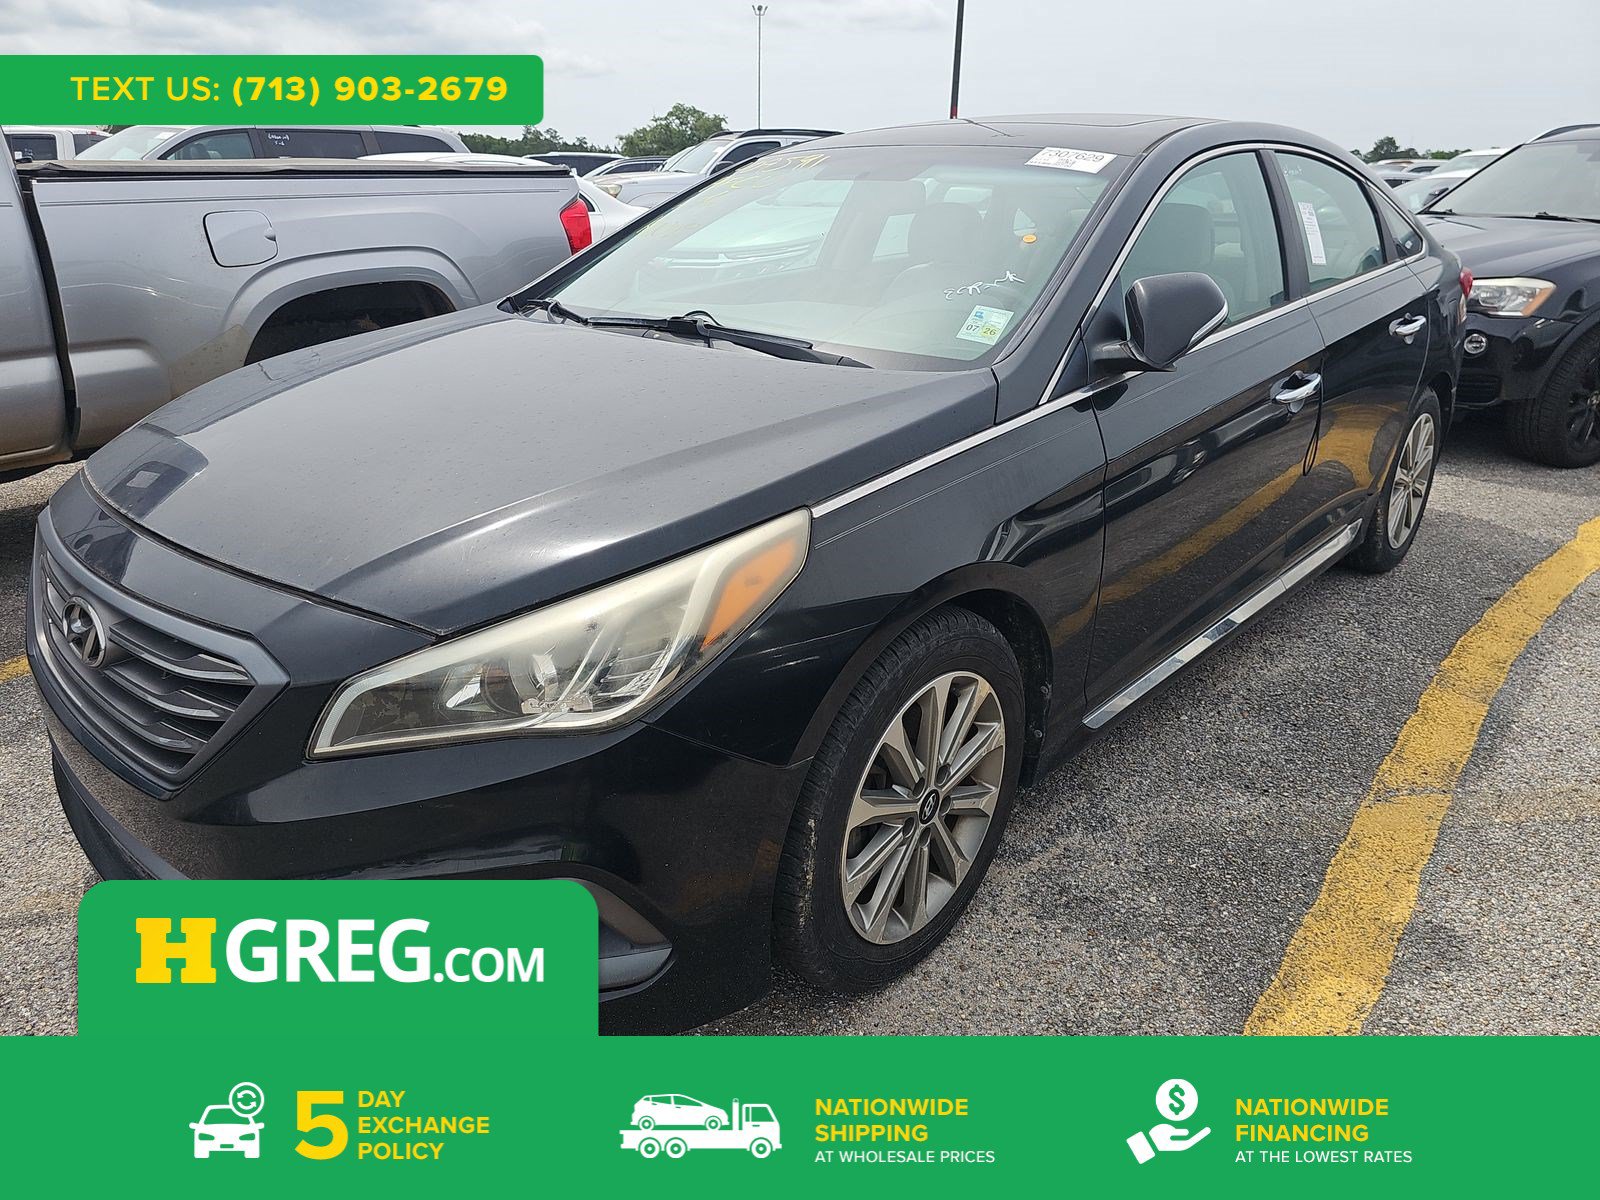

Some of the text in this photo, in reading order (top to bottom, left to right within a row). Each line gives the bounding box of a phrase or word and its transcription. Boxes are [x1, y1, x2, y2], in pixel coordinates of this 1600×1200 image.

[1041, 148, 1105, 163] 7307629
[965, 323, 997, 336] 07 26
